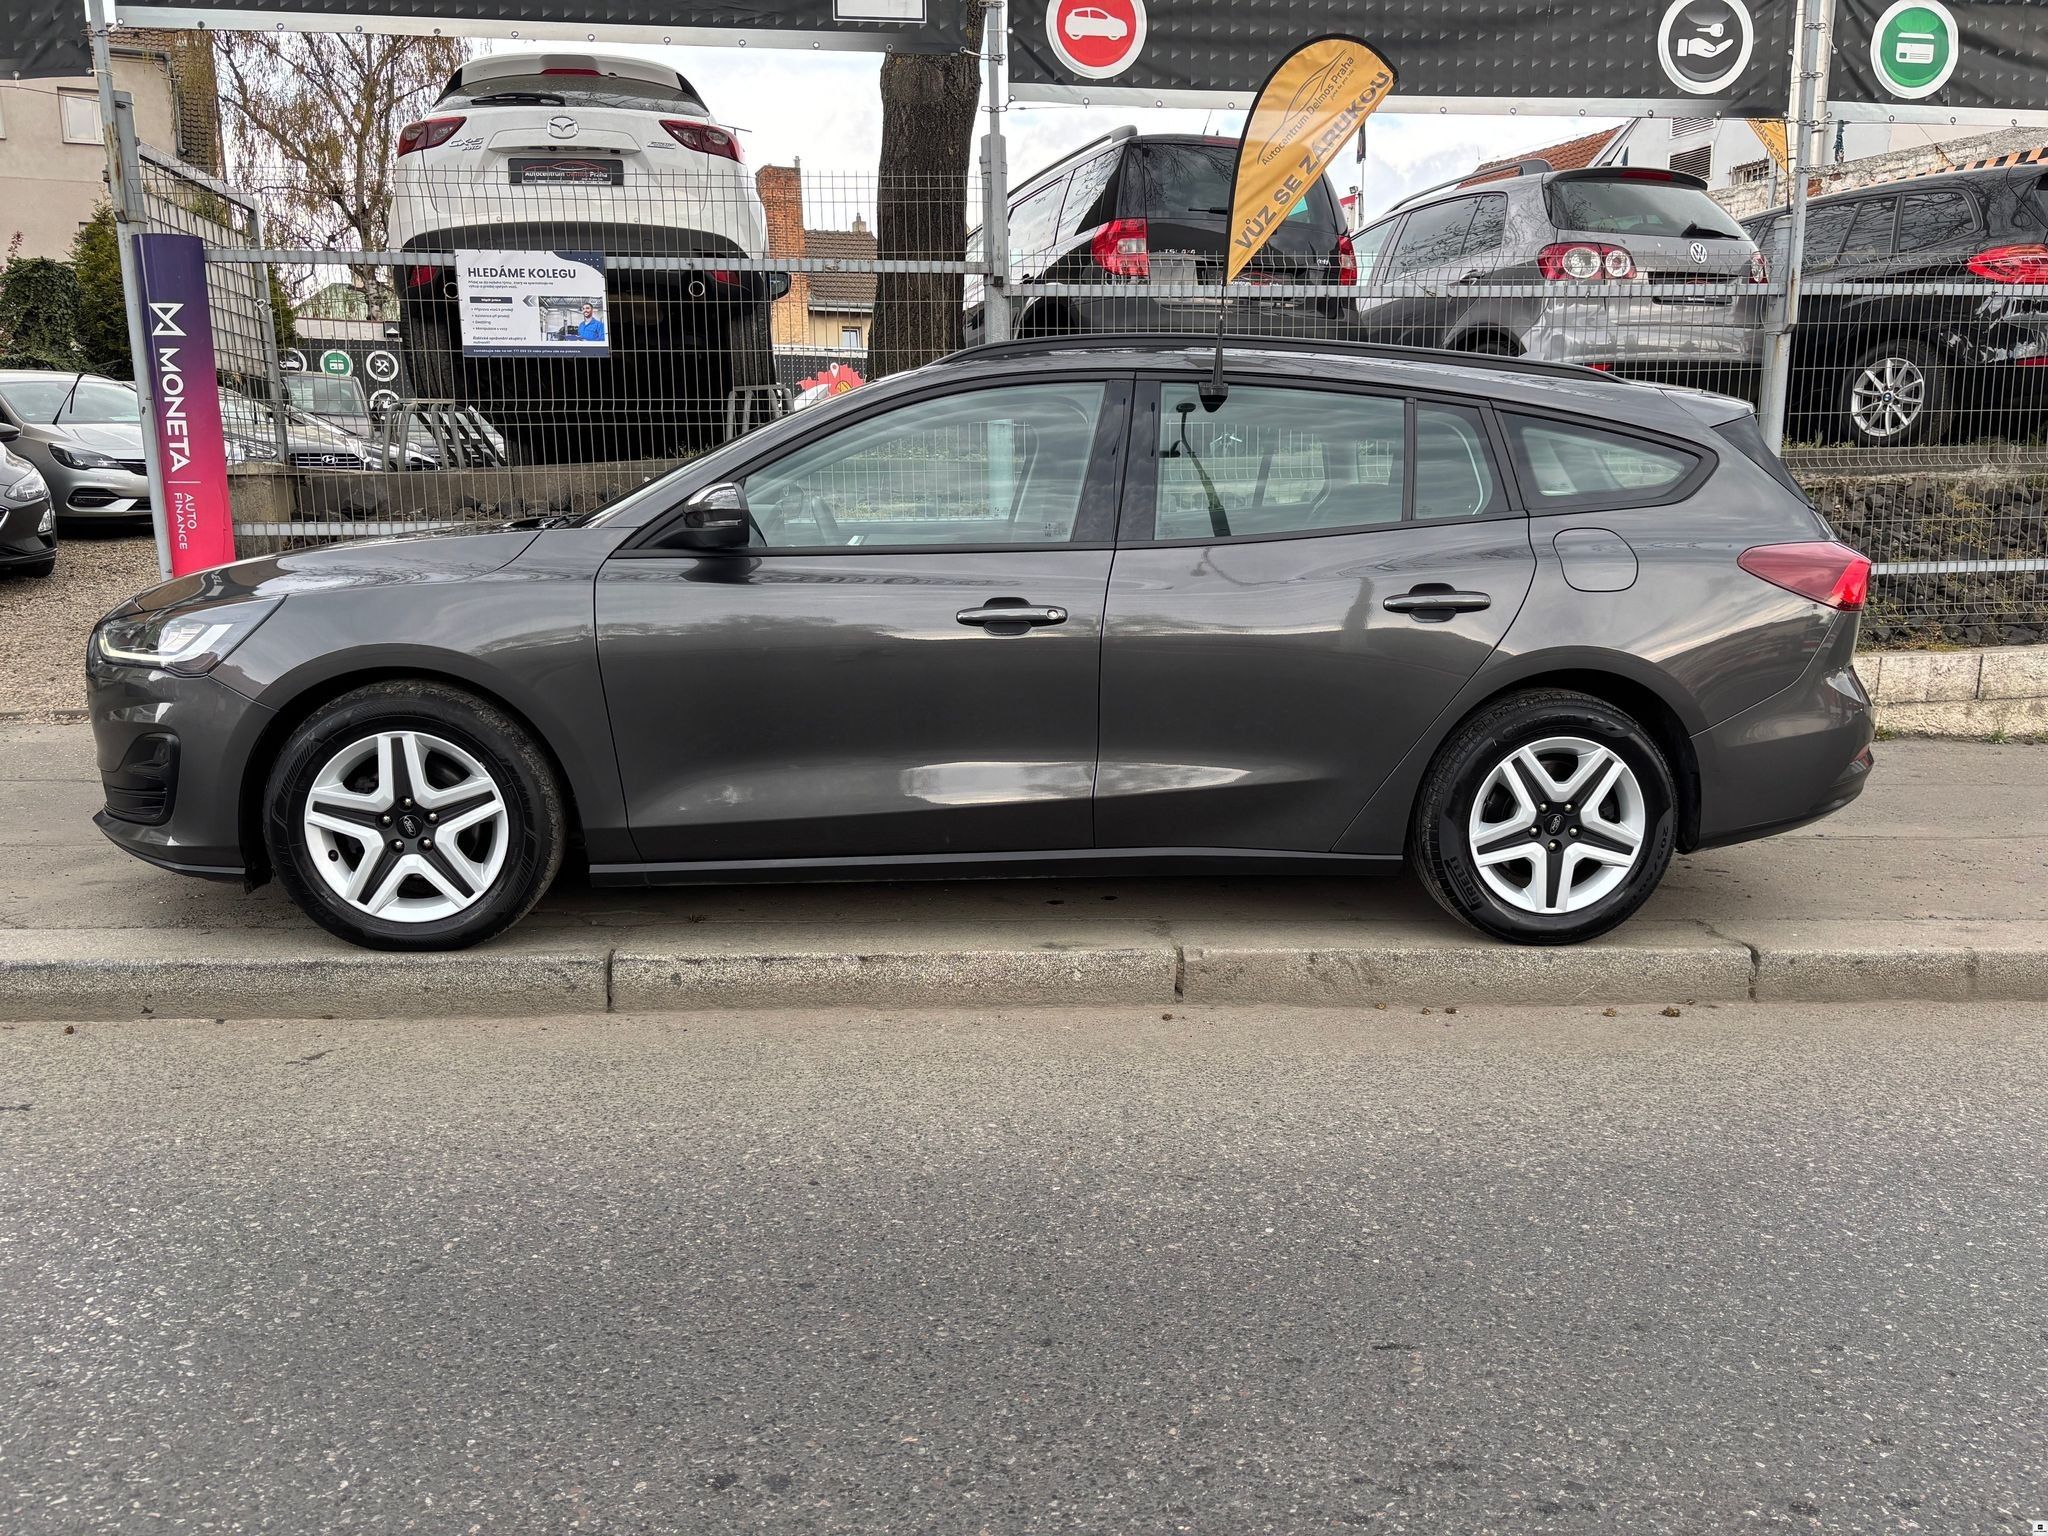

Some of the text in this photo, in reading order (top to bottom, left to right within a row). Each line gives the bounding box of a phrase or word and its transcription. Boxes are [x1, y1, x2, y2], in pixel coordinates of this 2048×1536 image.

[1261, 56, 1355, 166] Autocentrum Delmos Praha
[1235, 205, 1277, 252] VŮZ
[1273, 174, 1303, 207] SE
[1299, 71, 1391, 176] ZÁRUKOU
[468, 265, 576, 279] HLEDÁME KOLEGU
[159, 348, 191, 473] MONETA
[174, 493, 188, 550] FINANCE
[184, 493, 198, 530] AUTO
